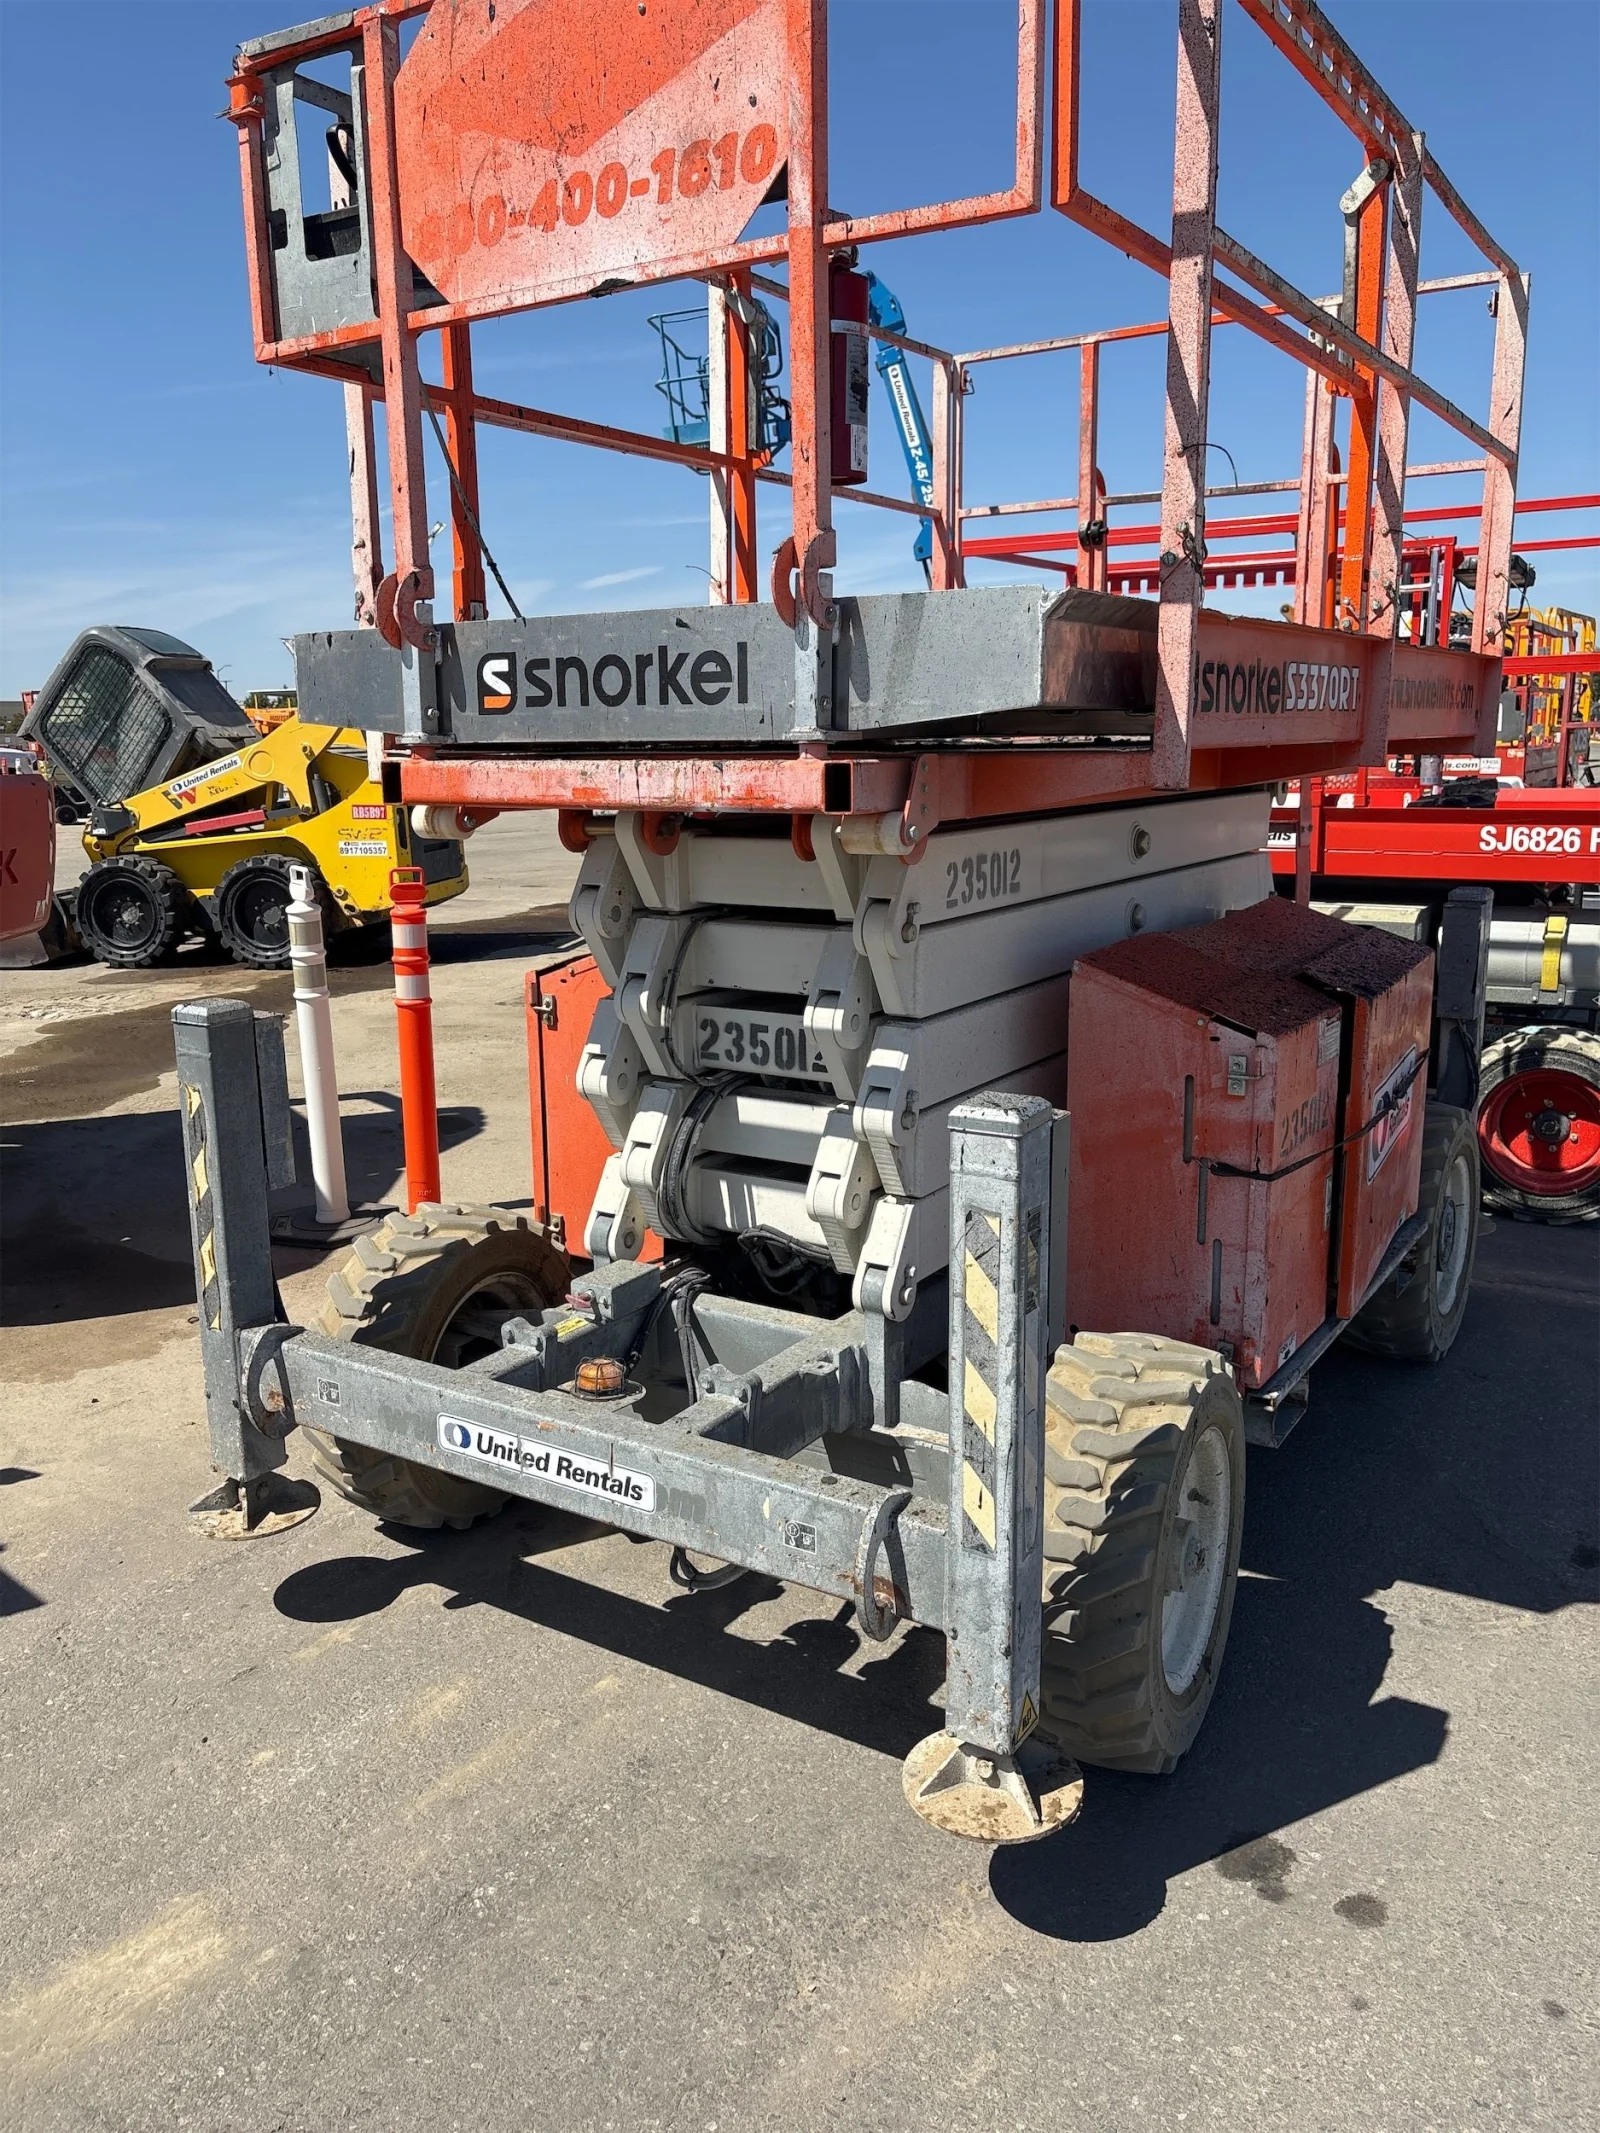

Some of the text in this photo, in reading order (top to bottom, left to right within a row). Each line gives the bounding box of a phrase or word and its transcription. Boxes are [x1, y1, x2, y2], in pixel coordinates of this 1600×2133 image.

[893, 379, 917, 443] United Rentals
[524, 641, 749, 708] snorkel
[1200, 657, 1361, 715] snorkel S3370RT
[183, 770, 209, 788] United
[209, 758, 238, 776] Rentals
[339, 846, 388, 855] 8917105357
[1478, 825, 1581, 854] SJ6826
[945, 848, 1022, 909] 235012
[476, 1431, 644, 1502] United Rentals
